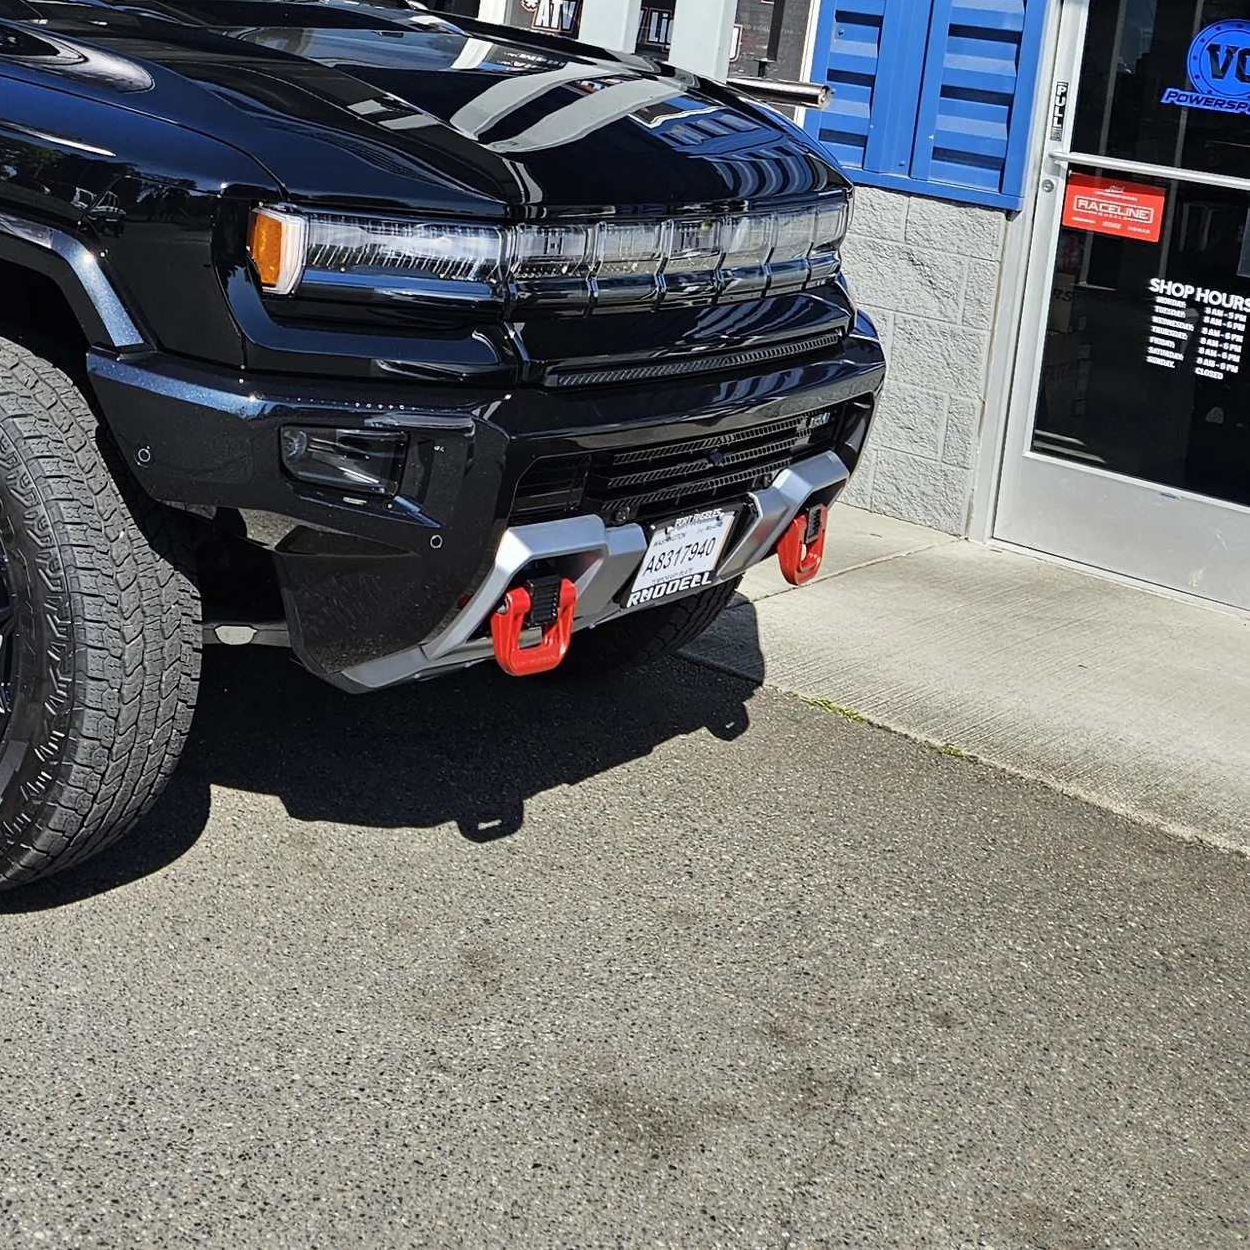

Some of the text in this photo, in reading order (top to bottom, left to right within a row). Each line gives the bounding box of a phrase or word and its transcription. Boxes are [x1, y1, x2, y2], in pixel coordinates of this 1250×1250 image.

[1052, 85, 1067, 128] PULL
[1165, 91, 1250, 114] POWERSP
[1077, 199, 1150, 220] RACELINE
[1149, 277, 1250, 313] SHOP HOURS
[642, 537, 716, 576] A8317940
